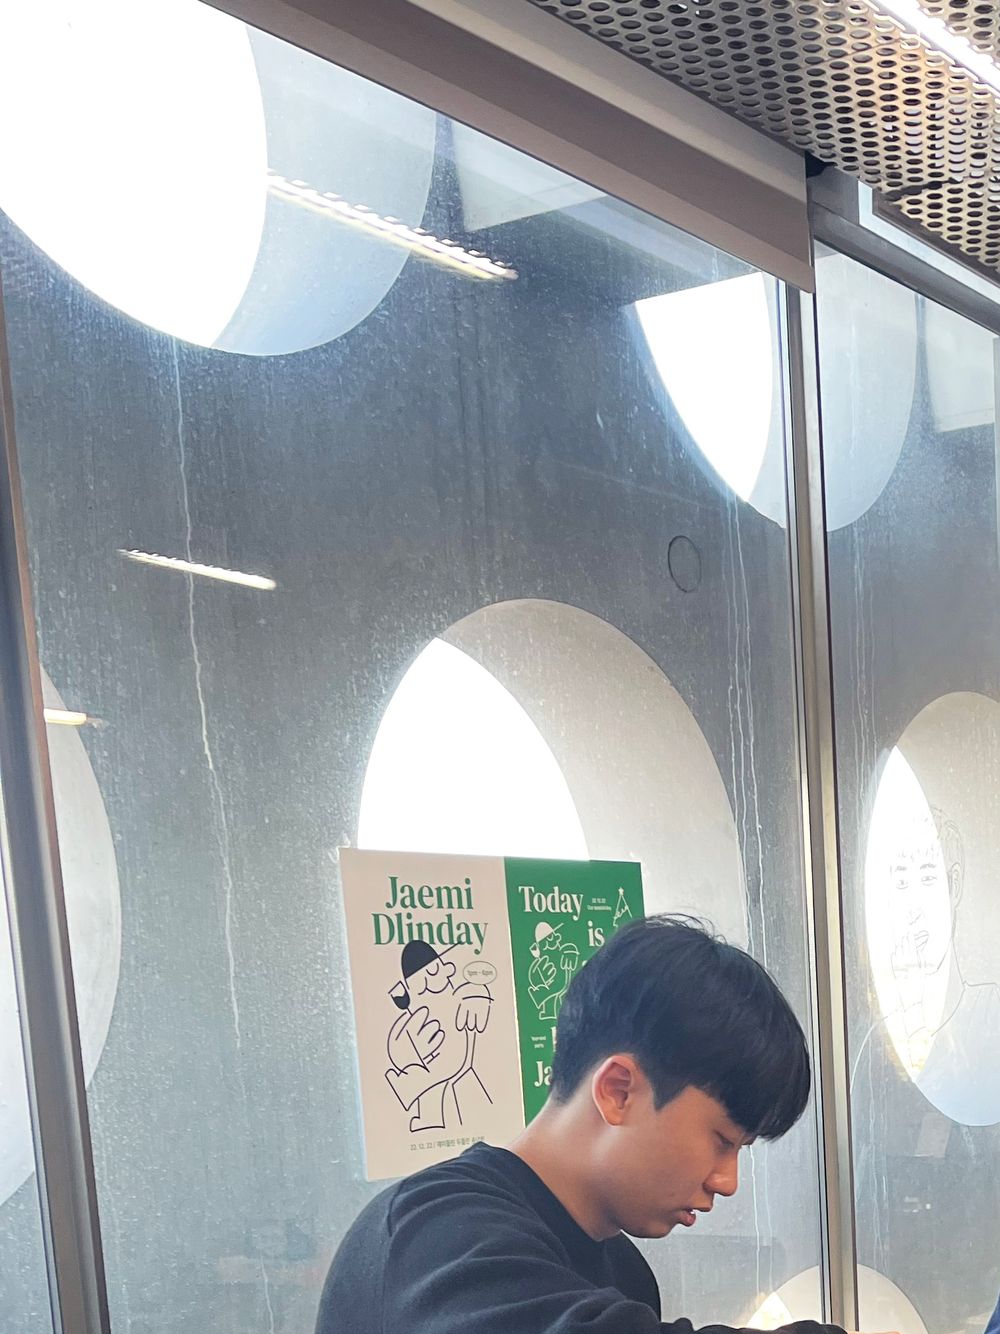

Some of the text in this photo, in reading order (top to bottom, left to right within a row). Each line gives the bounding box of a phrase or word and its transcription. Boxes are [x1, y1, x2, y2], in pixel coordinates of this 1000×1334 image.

[385, 876, 473, 909] Jaemi
[518, 885, 584, 921] Today
[372, 912, 488, 955] Dlinday
[587, 920, 605, 947] is
